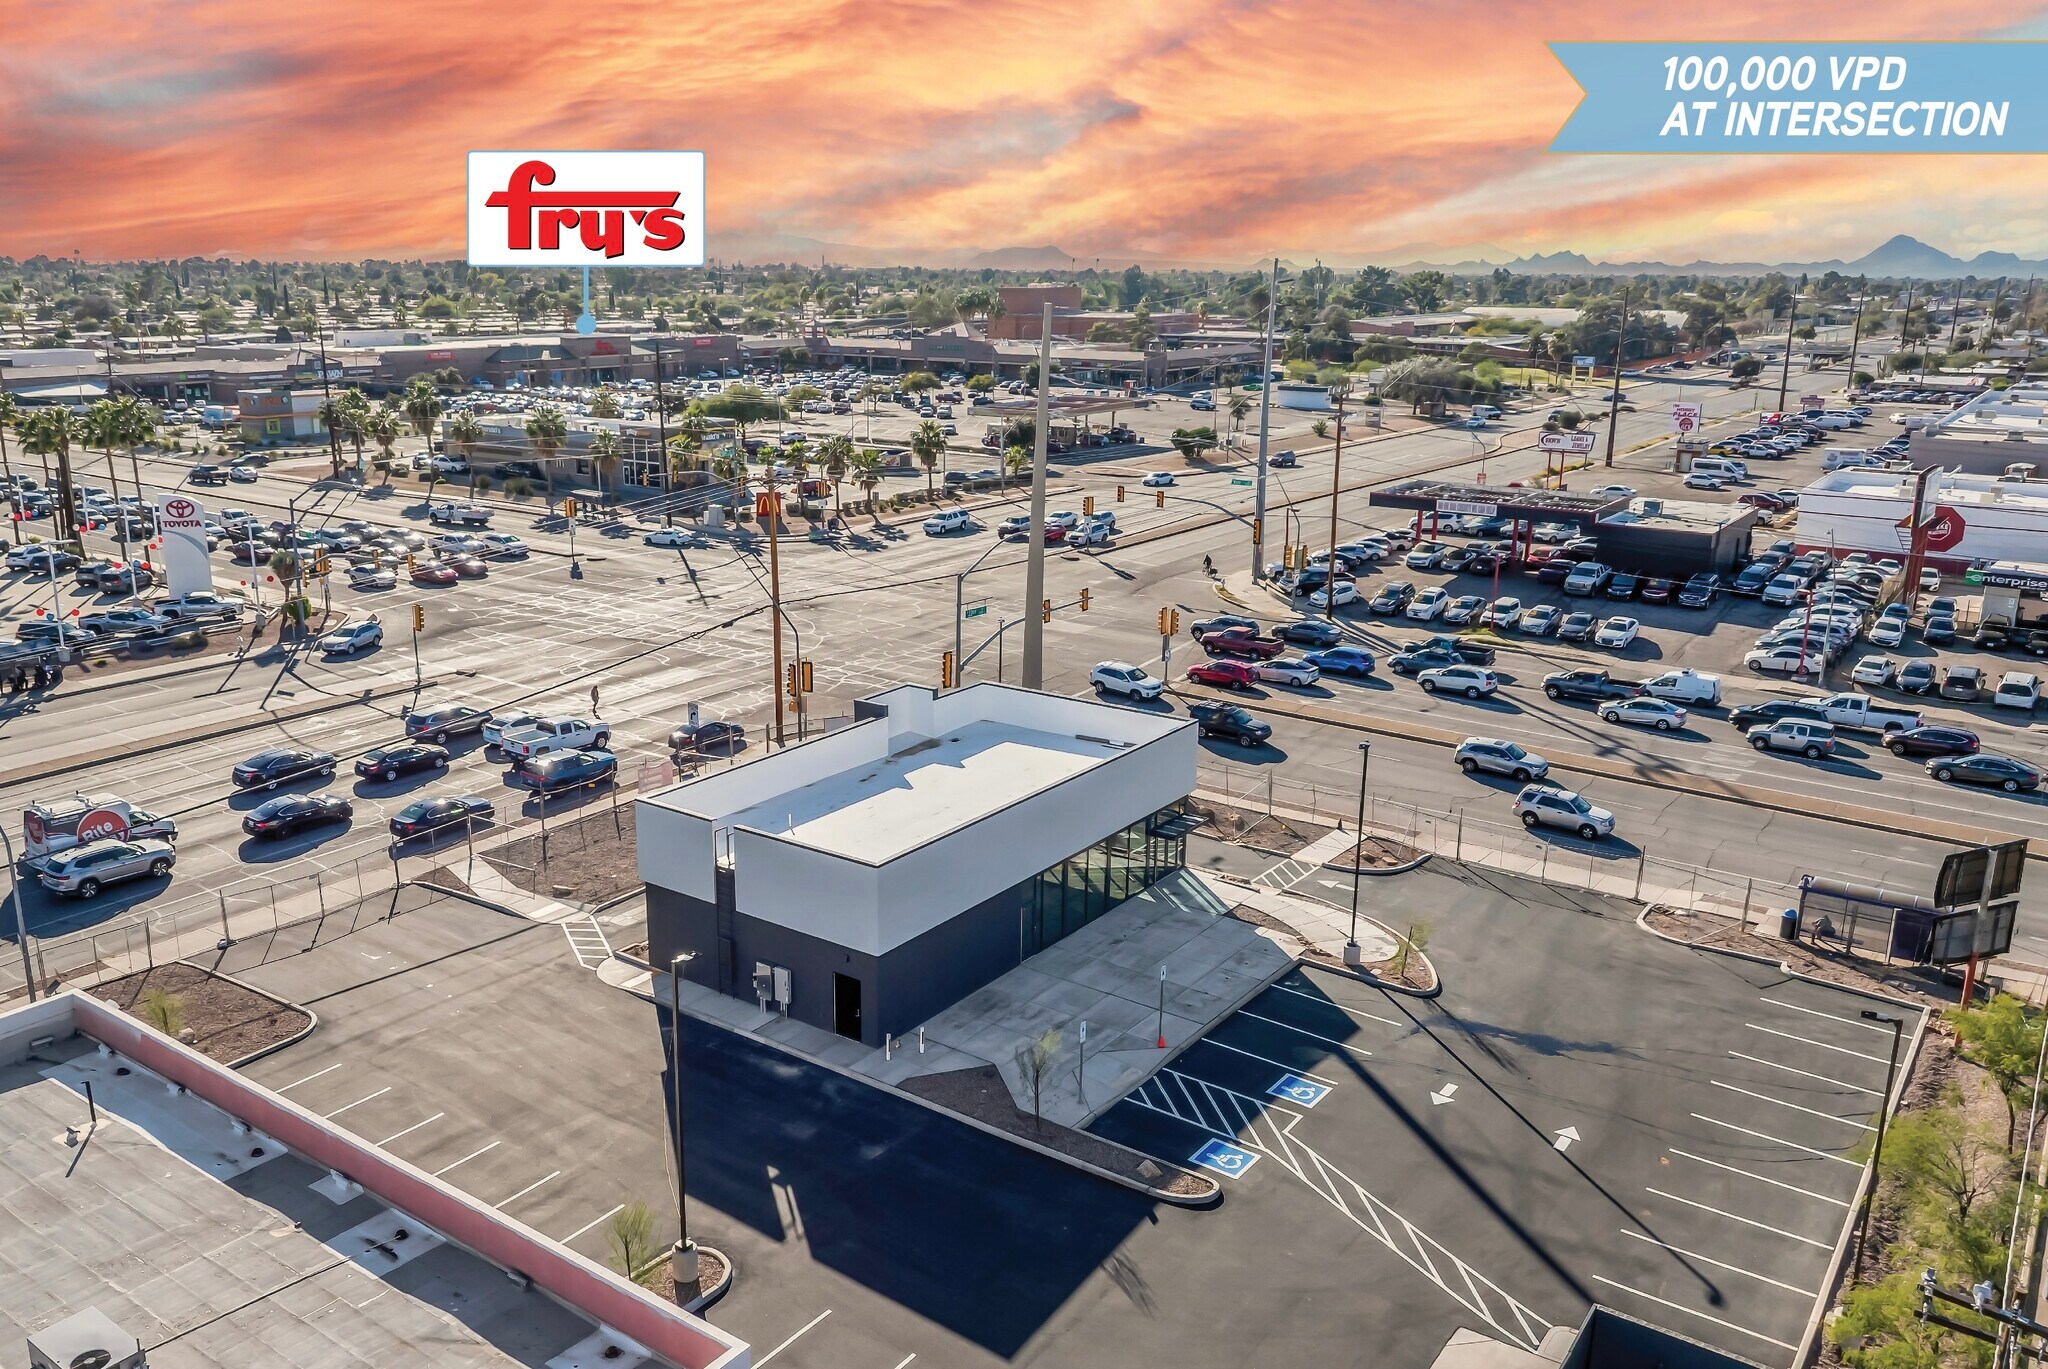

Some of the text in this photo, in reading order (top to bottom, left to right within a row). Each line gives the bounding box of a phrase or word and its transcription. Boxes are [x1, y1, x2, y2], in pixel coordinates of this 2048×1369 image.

[162, 520, 203, 528] TOYOTA
[1966, 574, 2048, 590] enterprise
[82, 820, 114, 842] Rite
